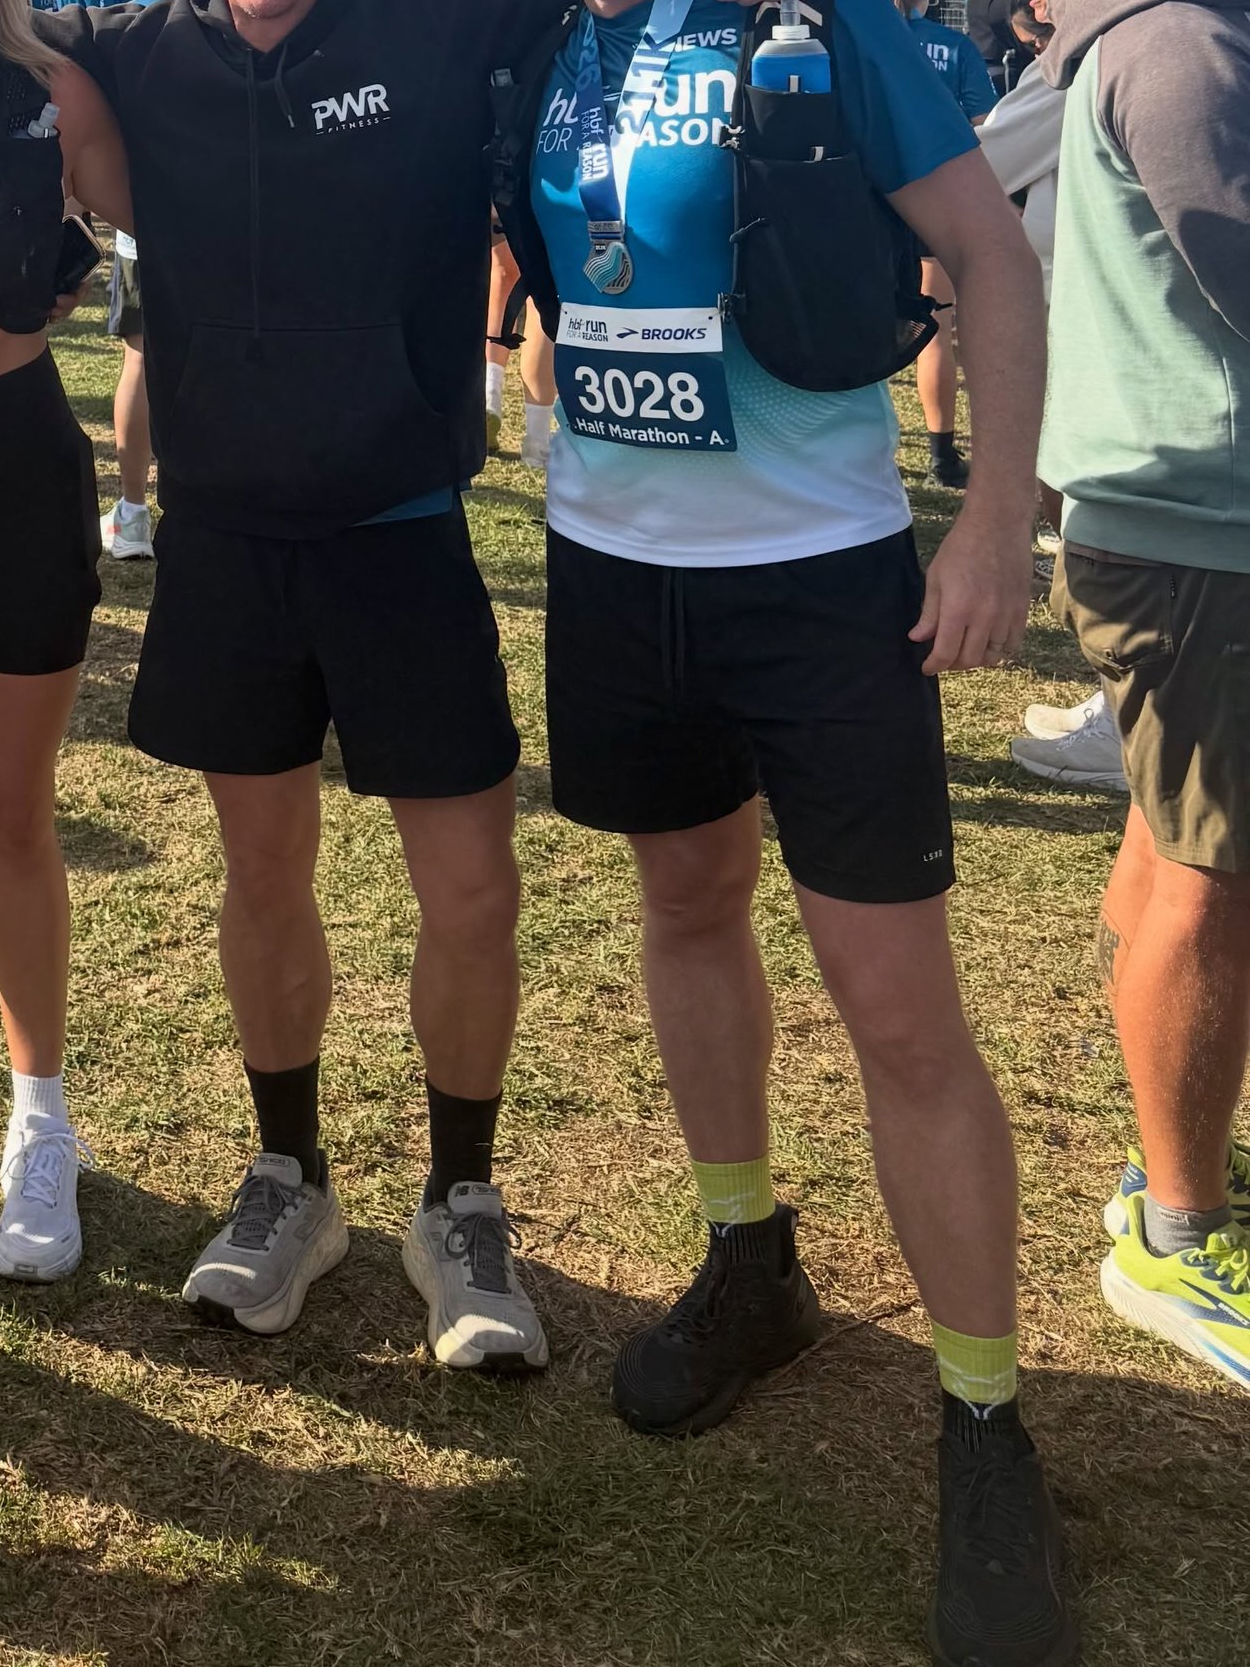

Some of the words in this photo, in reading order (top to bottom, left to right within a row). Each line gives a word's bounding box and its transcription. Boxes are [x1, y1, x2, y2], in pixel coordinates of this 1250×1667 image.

[311, 84, 390, 129] PWR
[654, 69, 736, 117] un
[328, 118, 380, 133] FITNESS
[581, 111, 590, 131] FOR
[589, 107, 604, 135] hbf
[536, 128, 572, 155] FOR
[582, 132, 590, 140] A
[582, 141, 592, 181] REASON
[592, 143, 609, 179] run
[568, 318, 583, 330] hbf
[586, 320, 607, 334] run
[582, 332, 609, 342] REASON
[641, 328, 707, 340] BROOKS
[574, 365, 705, 422] 3028
[576, 417, 606, 435] Half
[608, 423, 689, 444] Marathon
[710, 430, 724, 445] A
